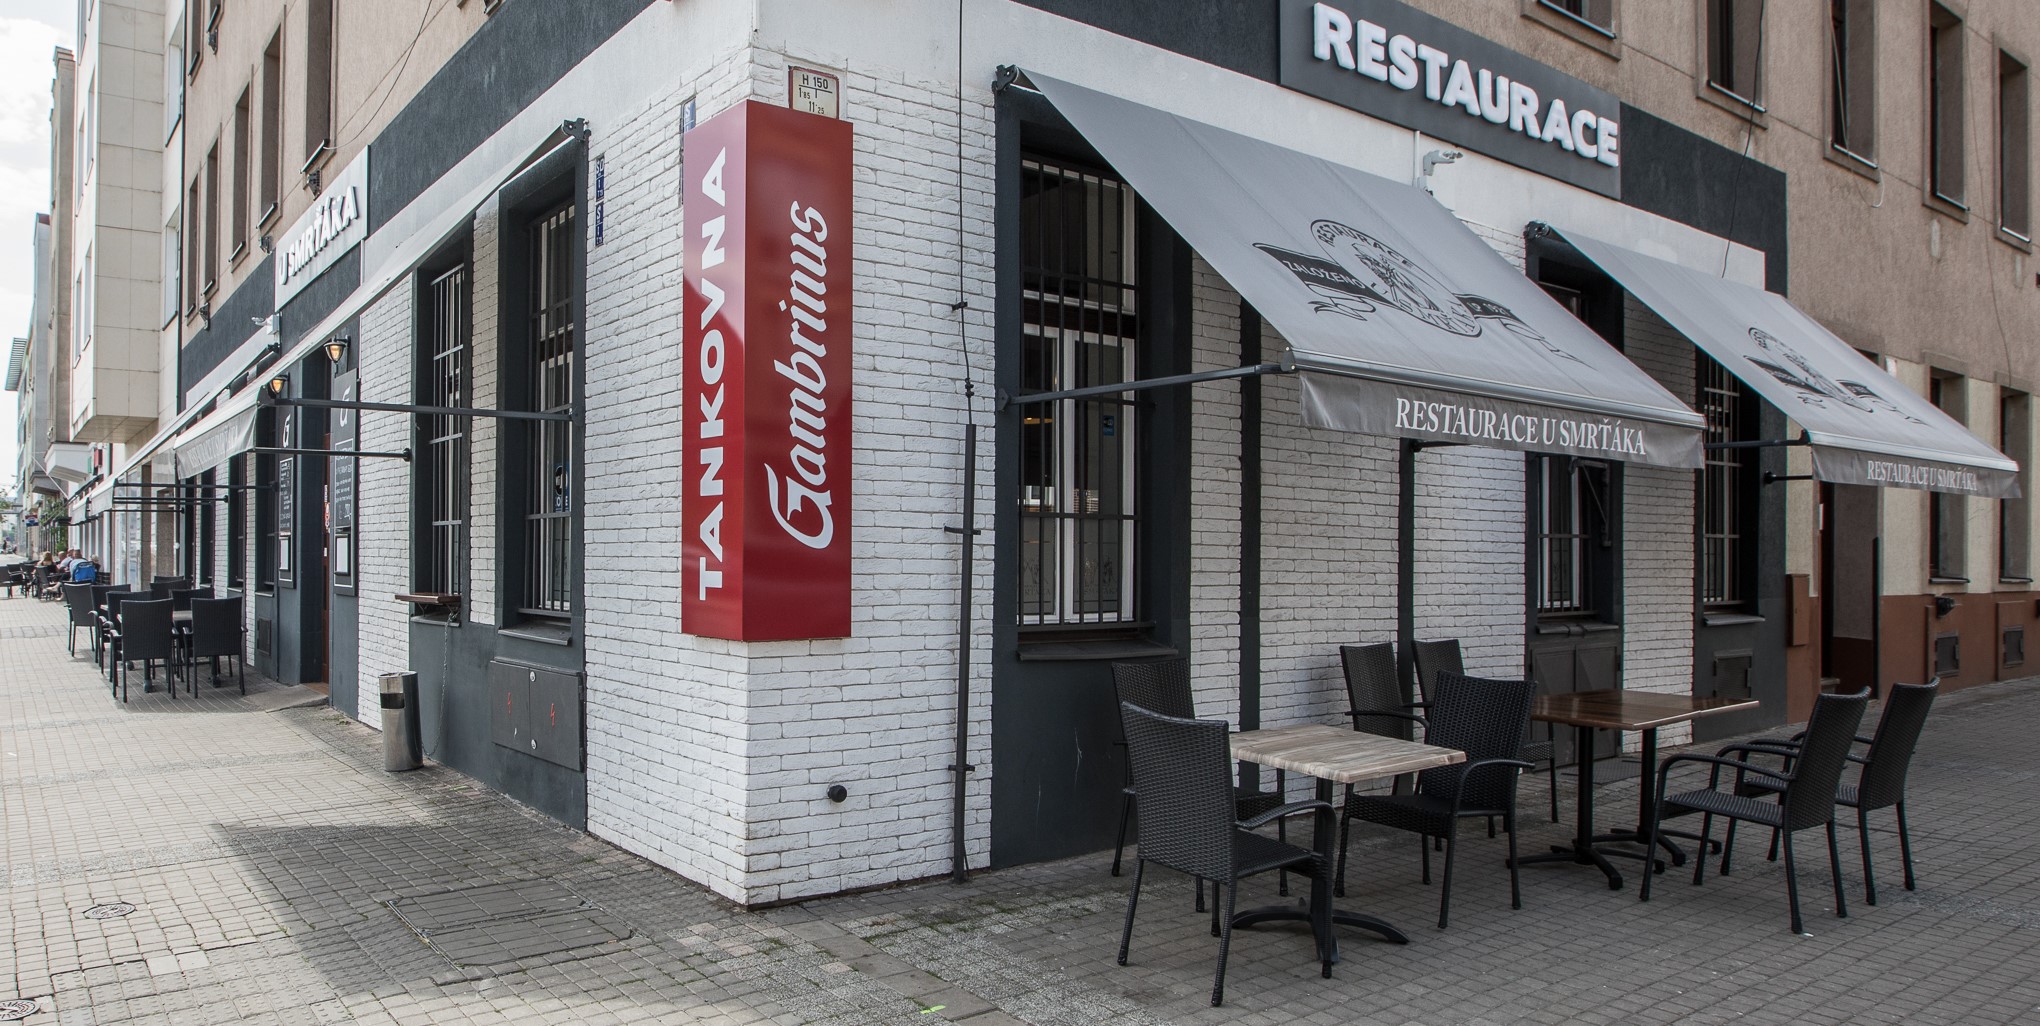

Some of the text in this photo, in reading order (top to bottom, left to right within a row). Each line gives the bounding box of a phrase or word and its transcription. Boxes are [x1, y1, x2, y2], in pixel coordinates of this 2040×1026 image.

[802, 74, 829, 90] H 150
[1313, 2, 1619, 168] RESTAURACE
[279, 185, 359, 285] U SMRŤÁKA
[699, 146, 726, 600] TANKOVNA
[764, 200, 834, 549] Gambrinus
[1395, 398, 1646, 455] RESTAURACE U SMRŤÁKA
[1867, 460, 1977, 491] RESTAURACE U SMRŤÁKA
